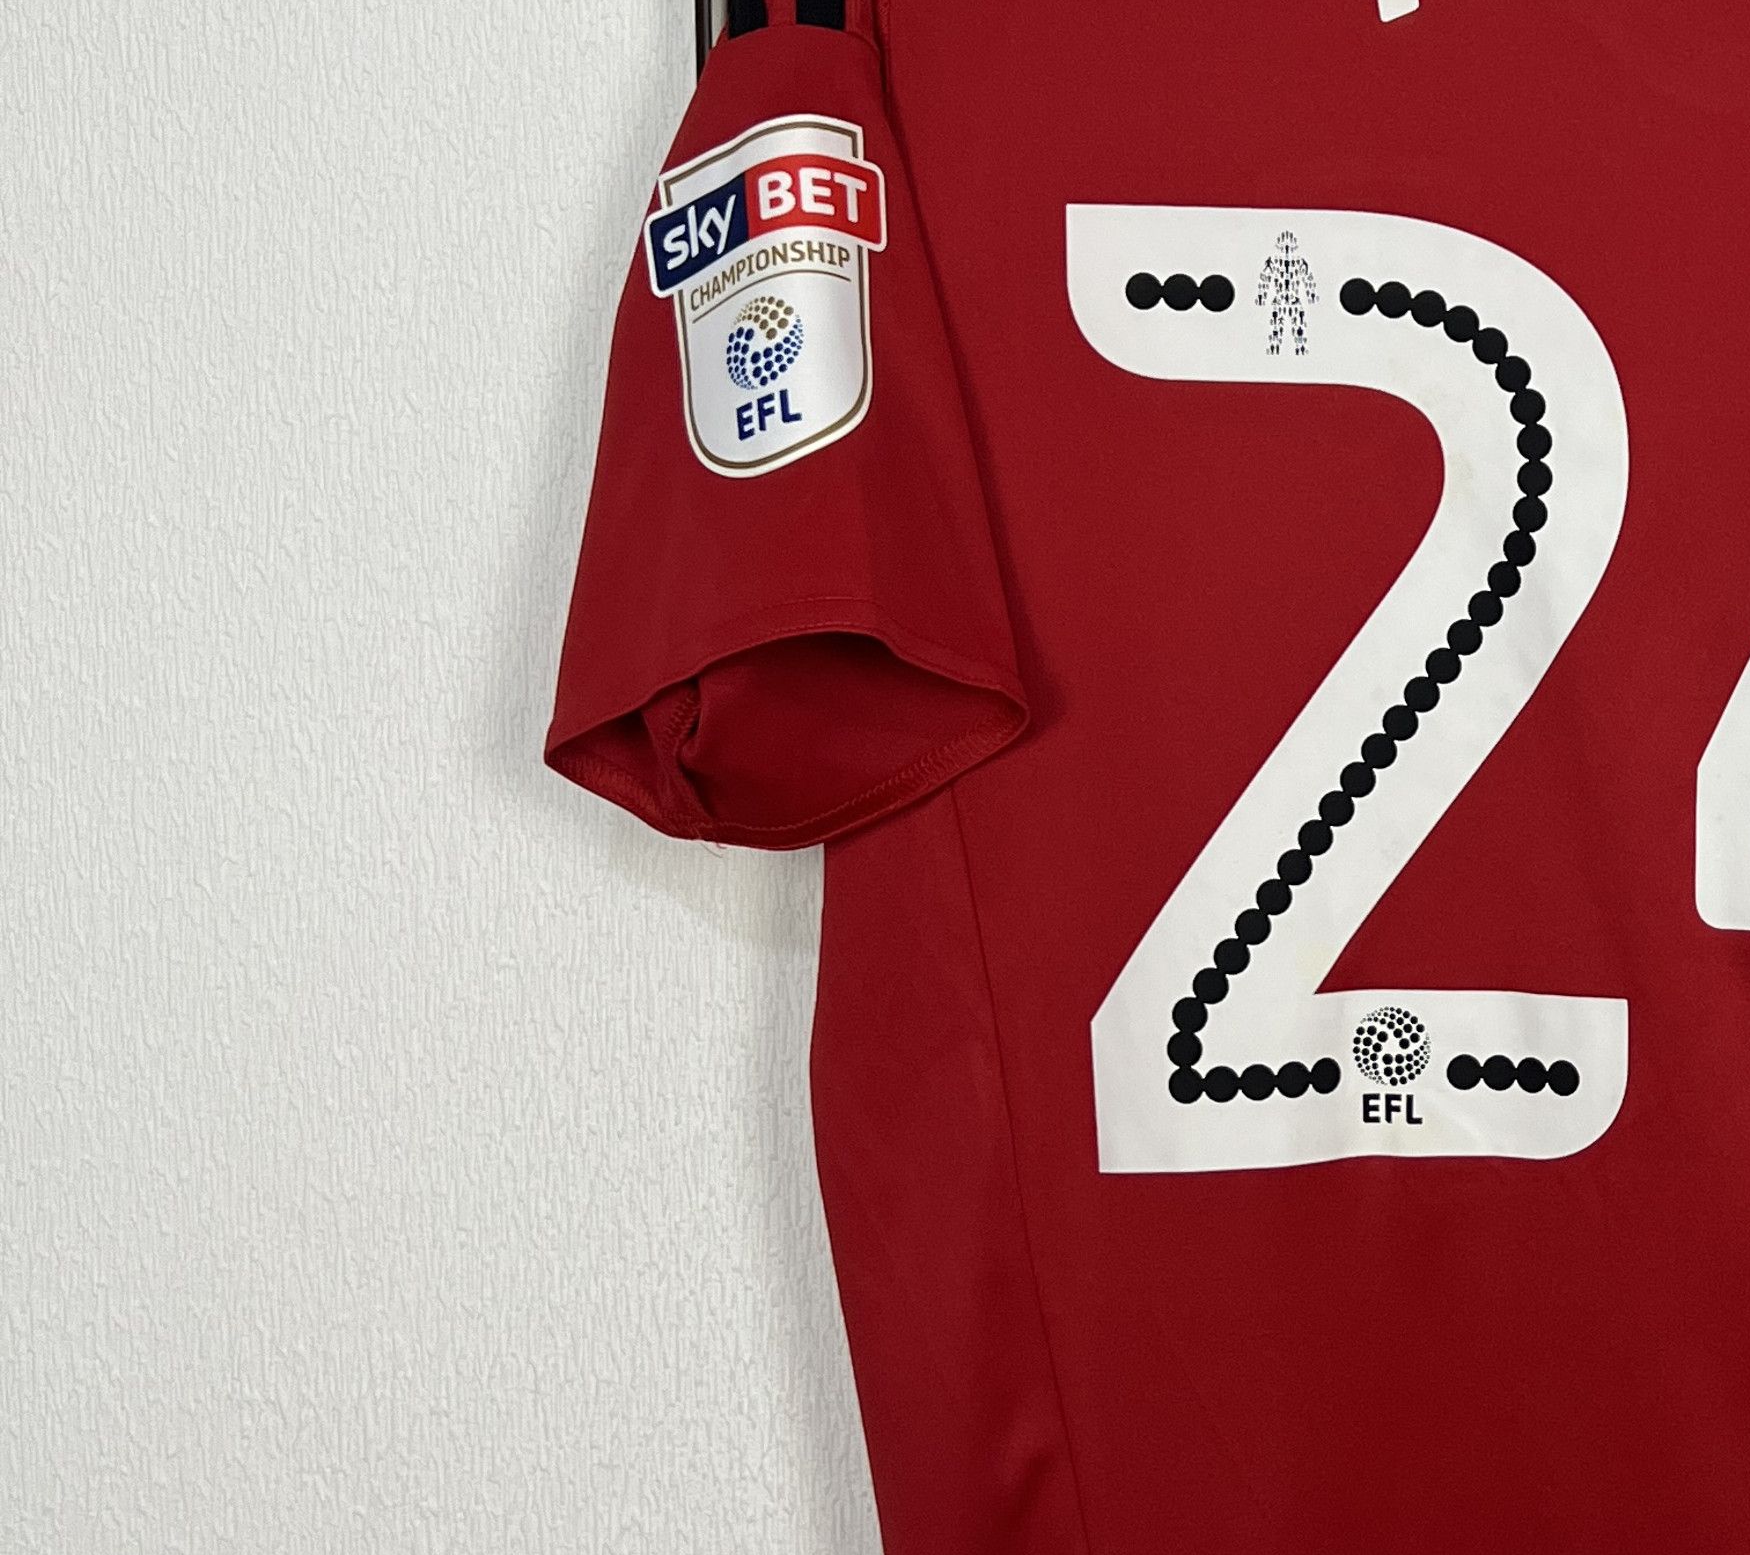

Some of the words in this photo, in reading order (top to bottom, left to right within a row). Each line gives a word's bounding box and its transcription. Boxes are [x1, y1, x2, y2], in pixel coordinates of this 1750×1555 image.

[757, 167, 867, 223] BET
[690, 241, 850, 312] CHAMPIONSHIP
[736, 388, 802, 442] EFL
[1362, 1093, 1424, 1125] EFL
